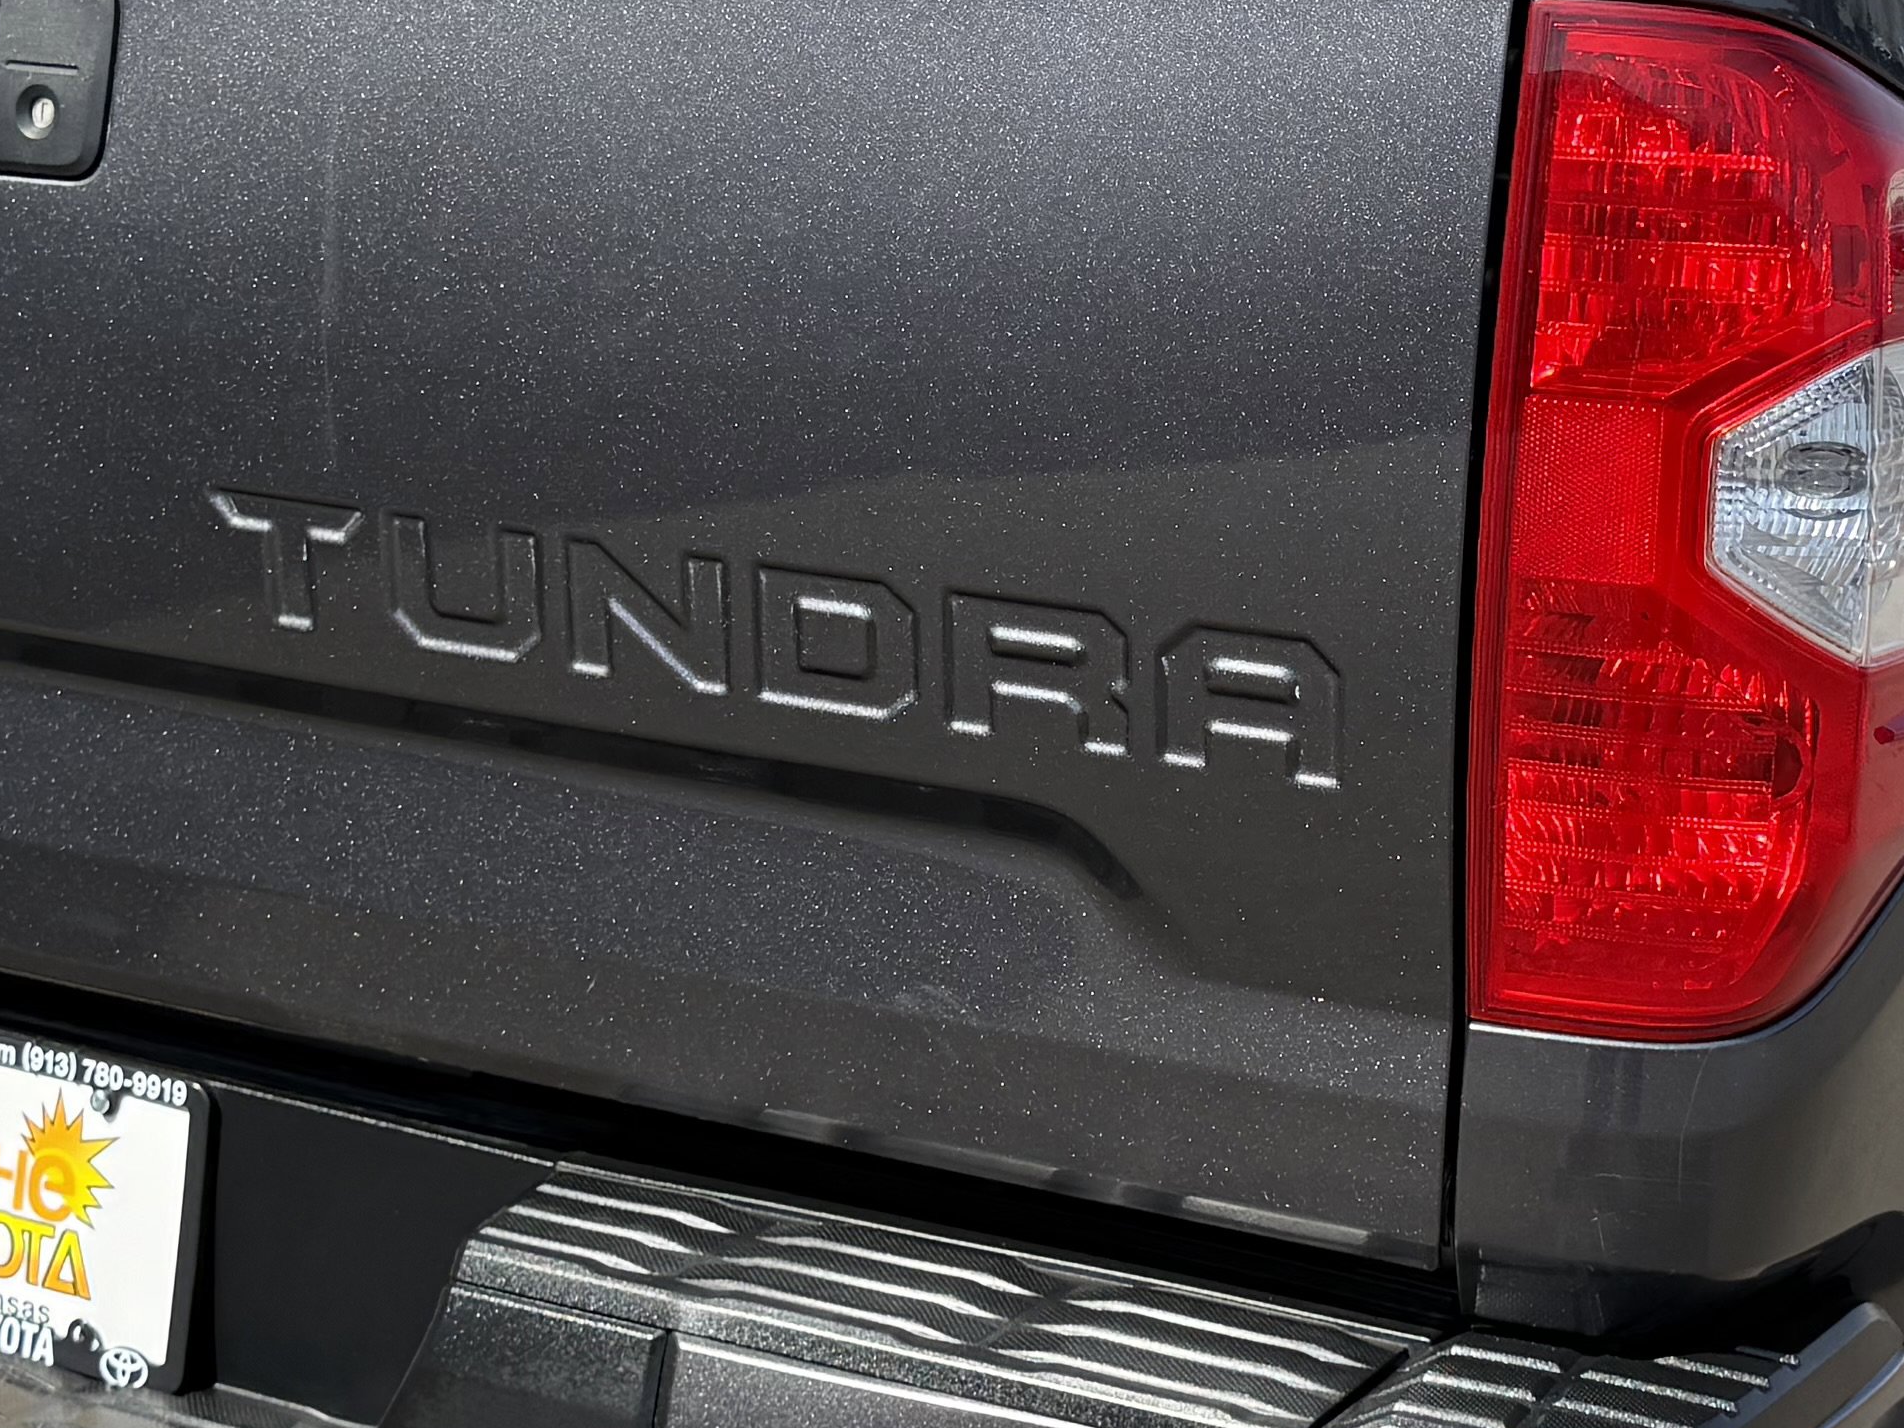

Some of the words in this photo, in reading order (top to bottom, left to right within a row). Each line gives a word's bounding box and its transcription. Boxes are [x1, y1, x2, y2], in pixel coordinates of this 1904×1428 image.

[208, 486, 1342, 791] TUNDRA
[21, 1040, 78, 1082] (913)
[81, 1057, 188, 1107] 780-9919
